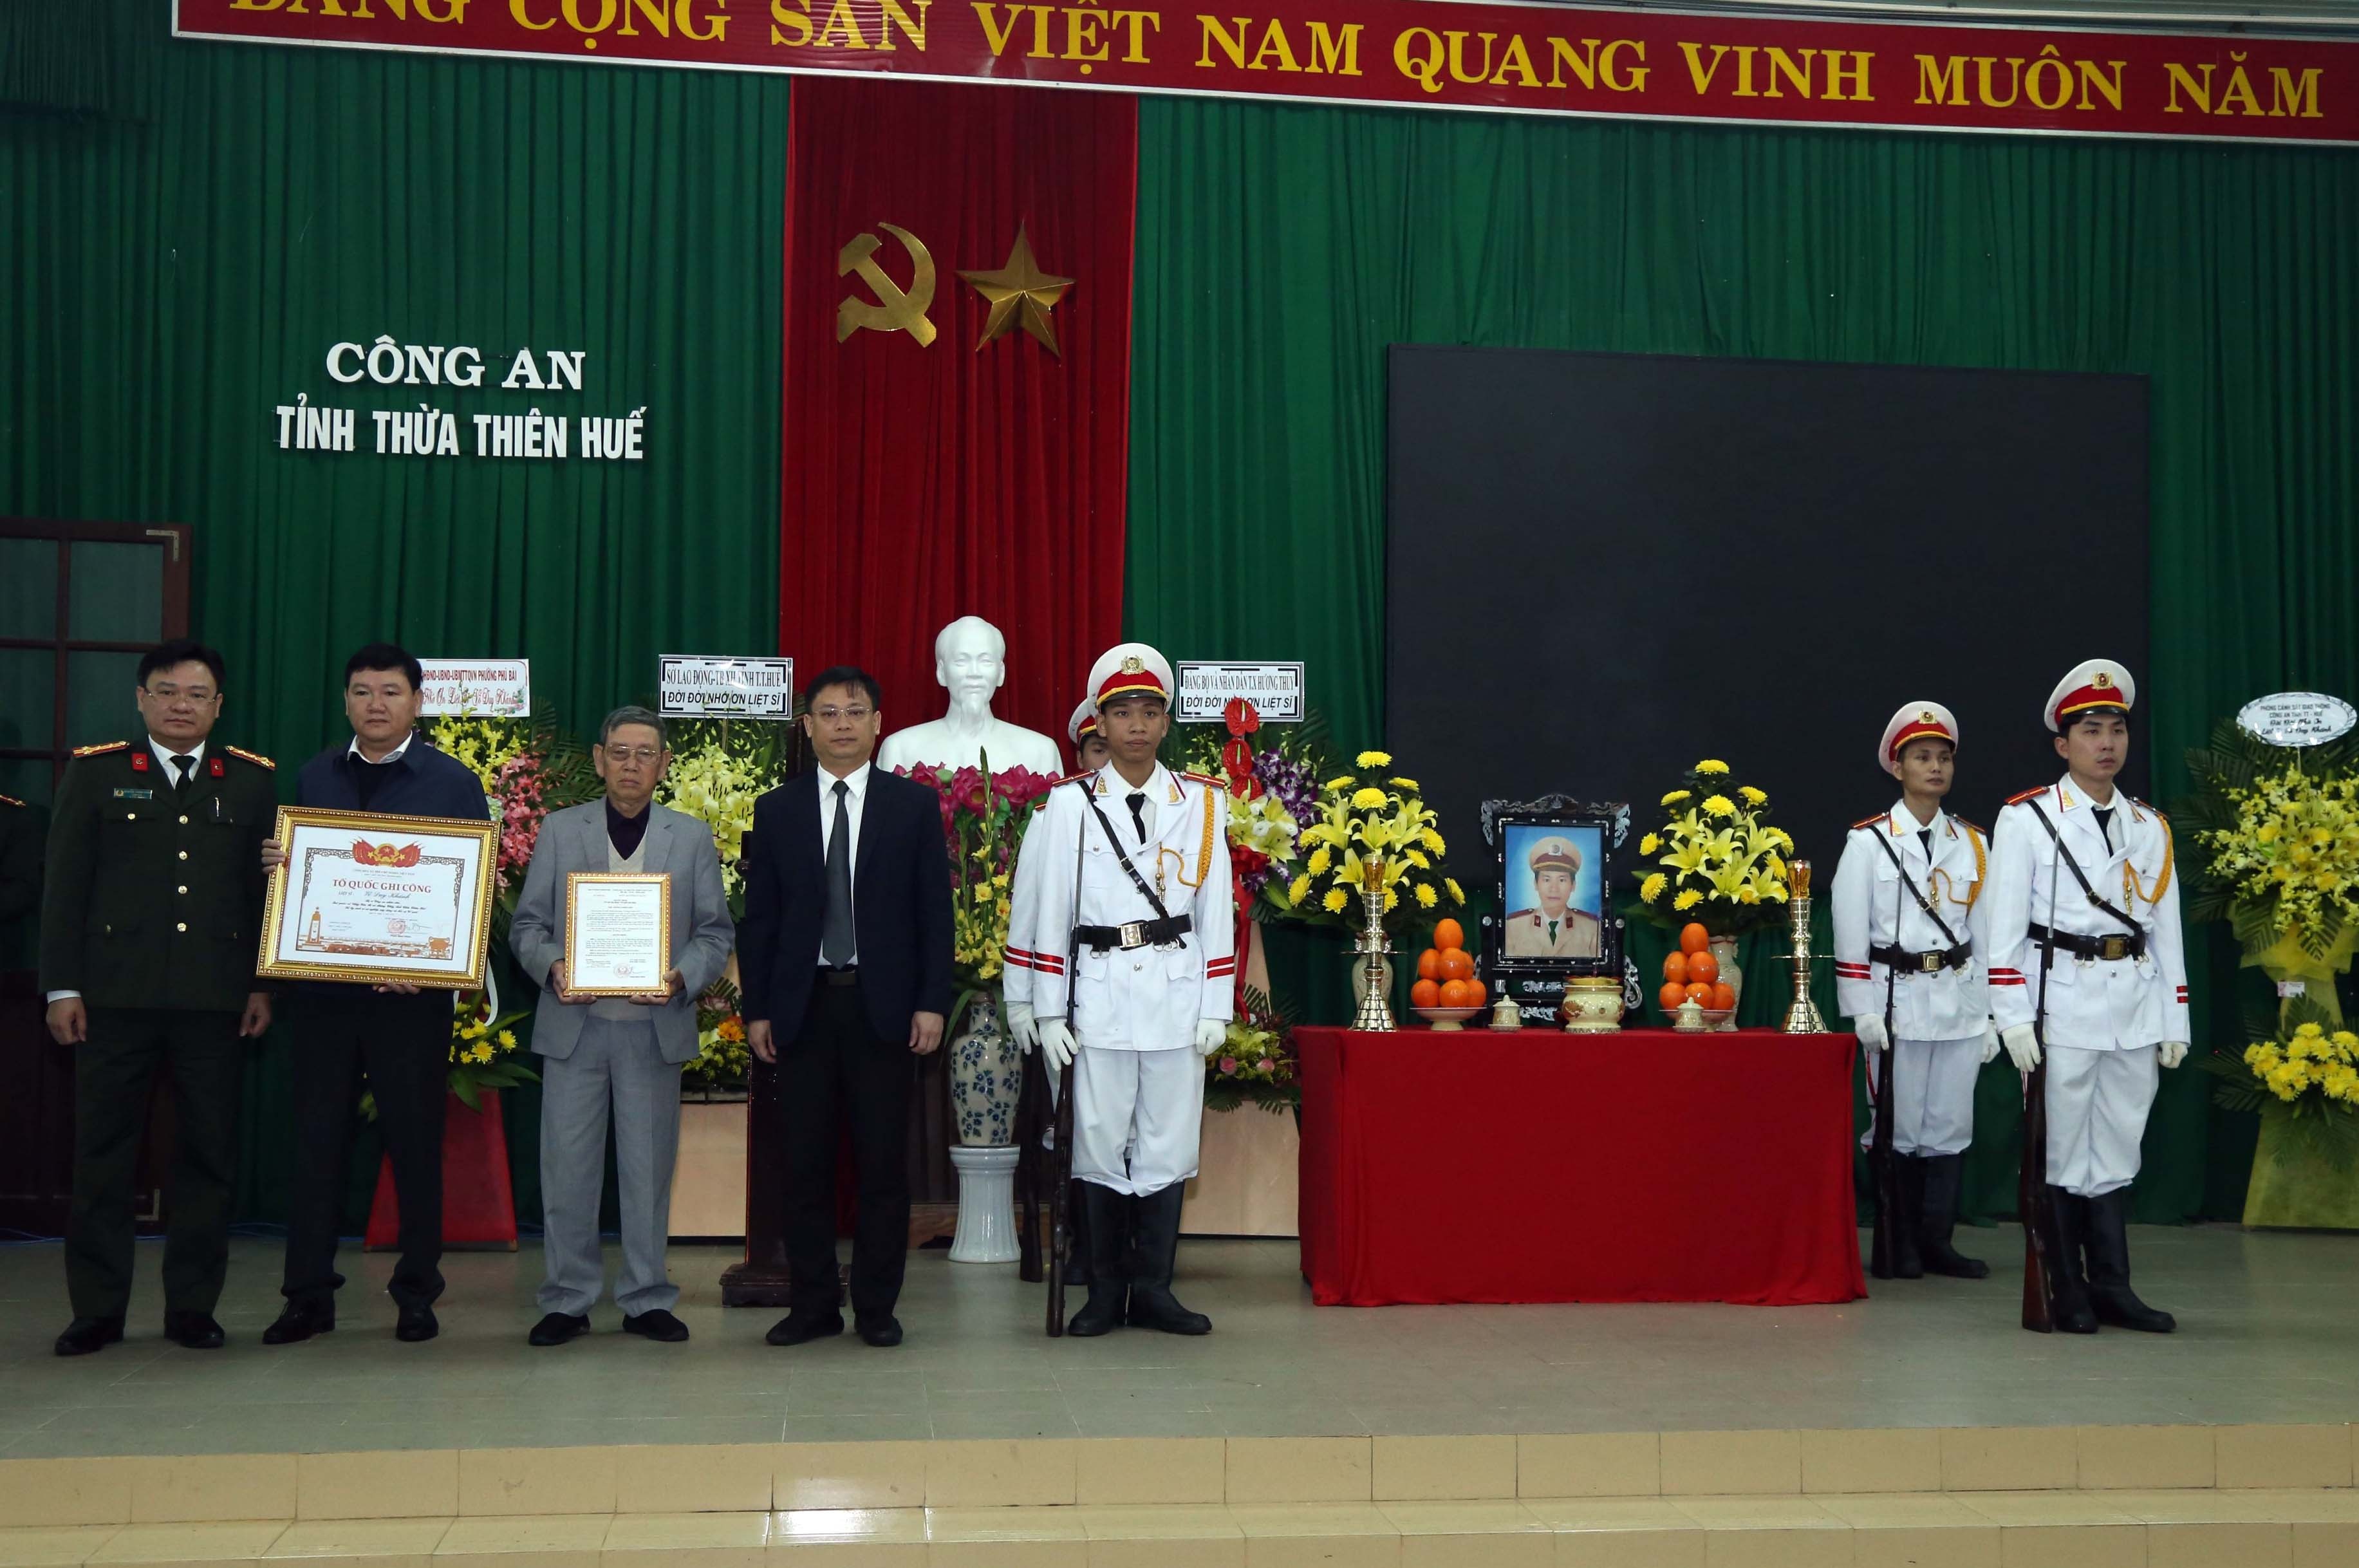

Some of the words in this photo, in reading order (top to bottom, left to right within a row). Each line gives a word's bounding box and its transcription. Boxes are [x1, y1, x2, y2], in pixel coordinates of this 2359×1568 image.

[971, 0, 1160, 74] VIỆT
[1195, 15, 1364, 75] NAM
[1394, 28, 1650, 93] QUANG
[1678, 42, 1874, 100] VINH
[1914, 44, 2126, 109] MUÔN
[2165, 51, 2322, 117] NĂM
[327, 335, 485, 386] CÔNG
[502, 350, 585, 389] AN
[277, 393, 353, 451] TỈNH
[373, 404, 459, 455] THỪA
[474, 408, 566, 457] THIÊN
[582, 407, 646, 458] HUẾ
[667, 664, 676, 684] SỞ
[677, 669, 691, 684] LAO
[1210, 670, 1218, 689] VÀ
[1236, 671, 1247, 690] DÂN
[668, 689, 685, 703] ĐỜI
[687, 690, 705, 704] ĐỜI
[707, 691, 729, 704] NHỚ
[731, 693, 745, 704] ƠN
[748, 692, 769, 707] LIỆT
[771, 692, 781, 705] SĨ
[1186, 695, 1202, 707] ĐỜI
[1205, 695, 1221, 707] ĐỜI
[1262, 696, 1282, 711] LIỆT
[1283, 695, 1292, 708] SĨ
[333, 878, 346, 888] TỔ
[348, 879, 379, 890] QUỐC
[380, 882, 400, 891] GHI
[402, 884, 432, 893] CÔNG
